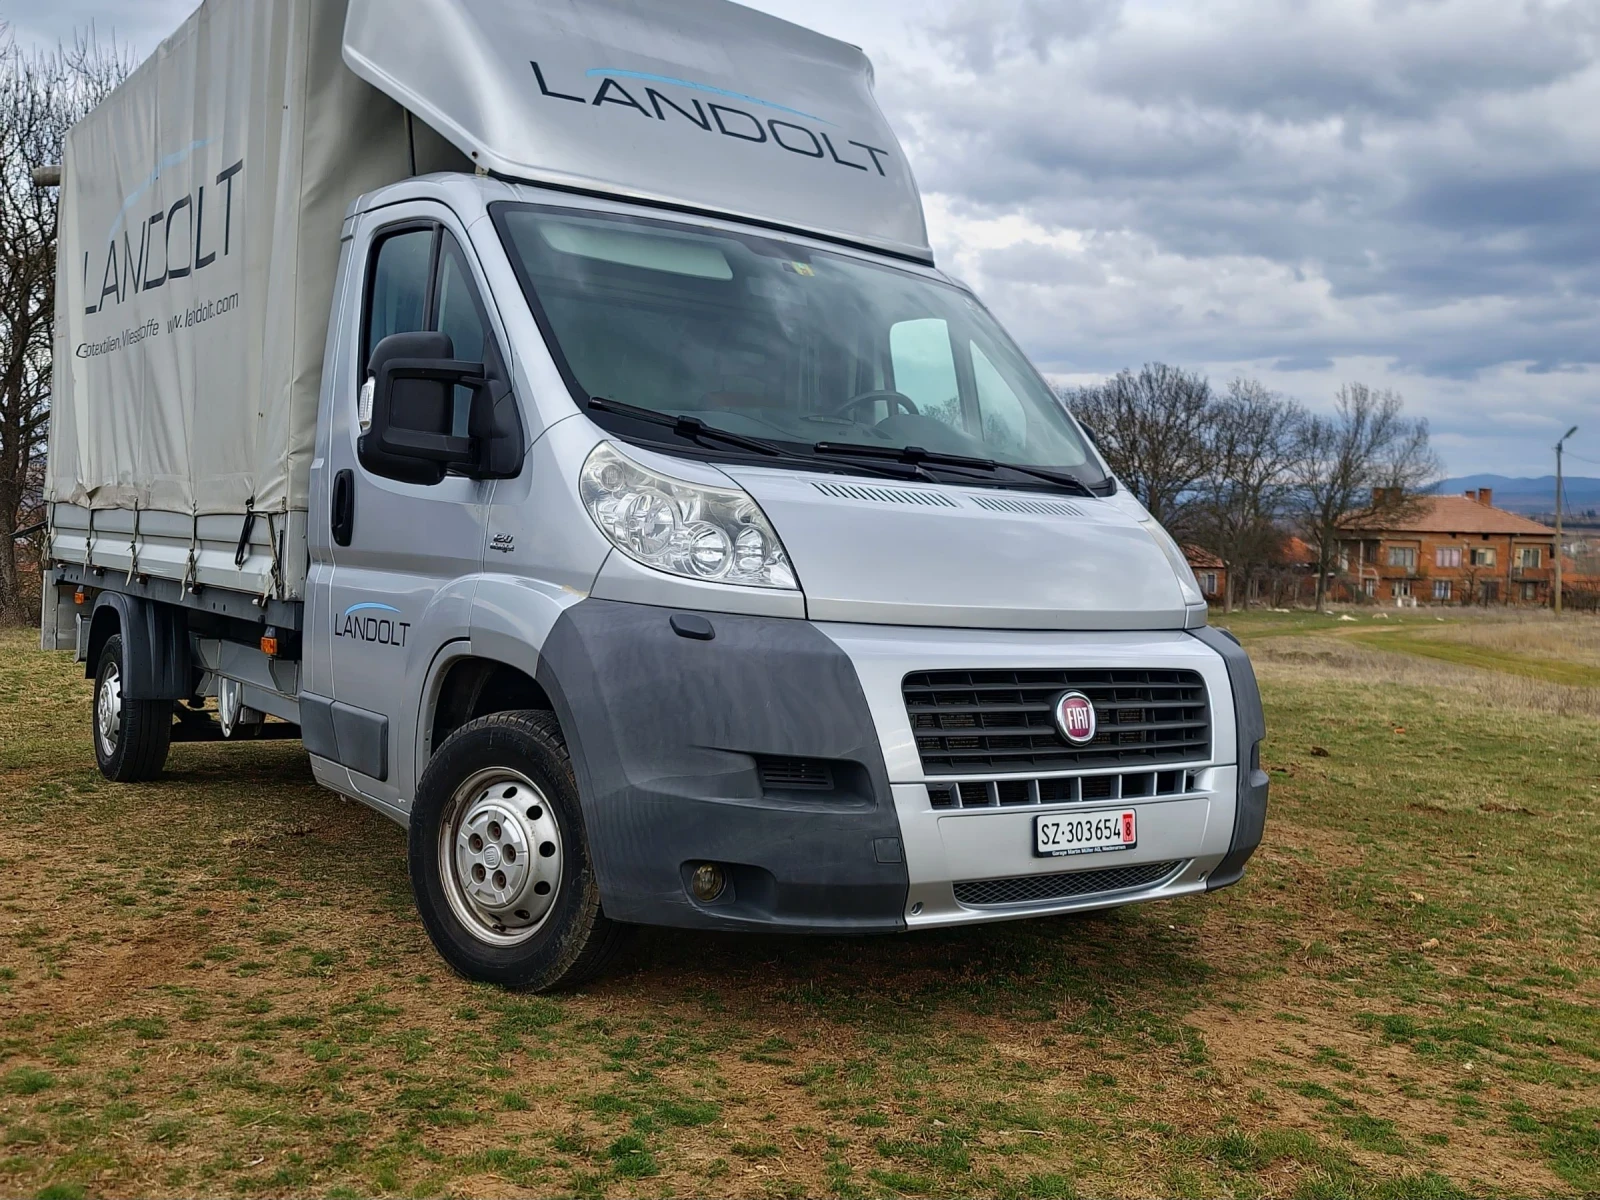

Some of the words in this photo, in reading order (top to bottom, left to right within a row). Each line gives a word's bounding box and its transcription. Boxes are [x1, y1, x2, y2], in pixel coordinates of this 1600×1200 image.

[529, 60, 889, 177] LANDOLT
[83, 158, 243, 315] LANDOLT
[167, 292, 239, 334] ww.landolt.com
[334, 613, 411, 647] LANDOLT
[1067, 706, 1089, 730] FIAT
